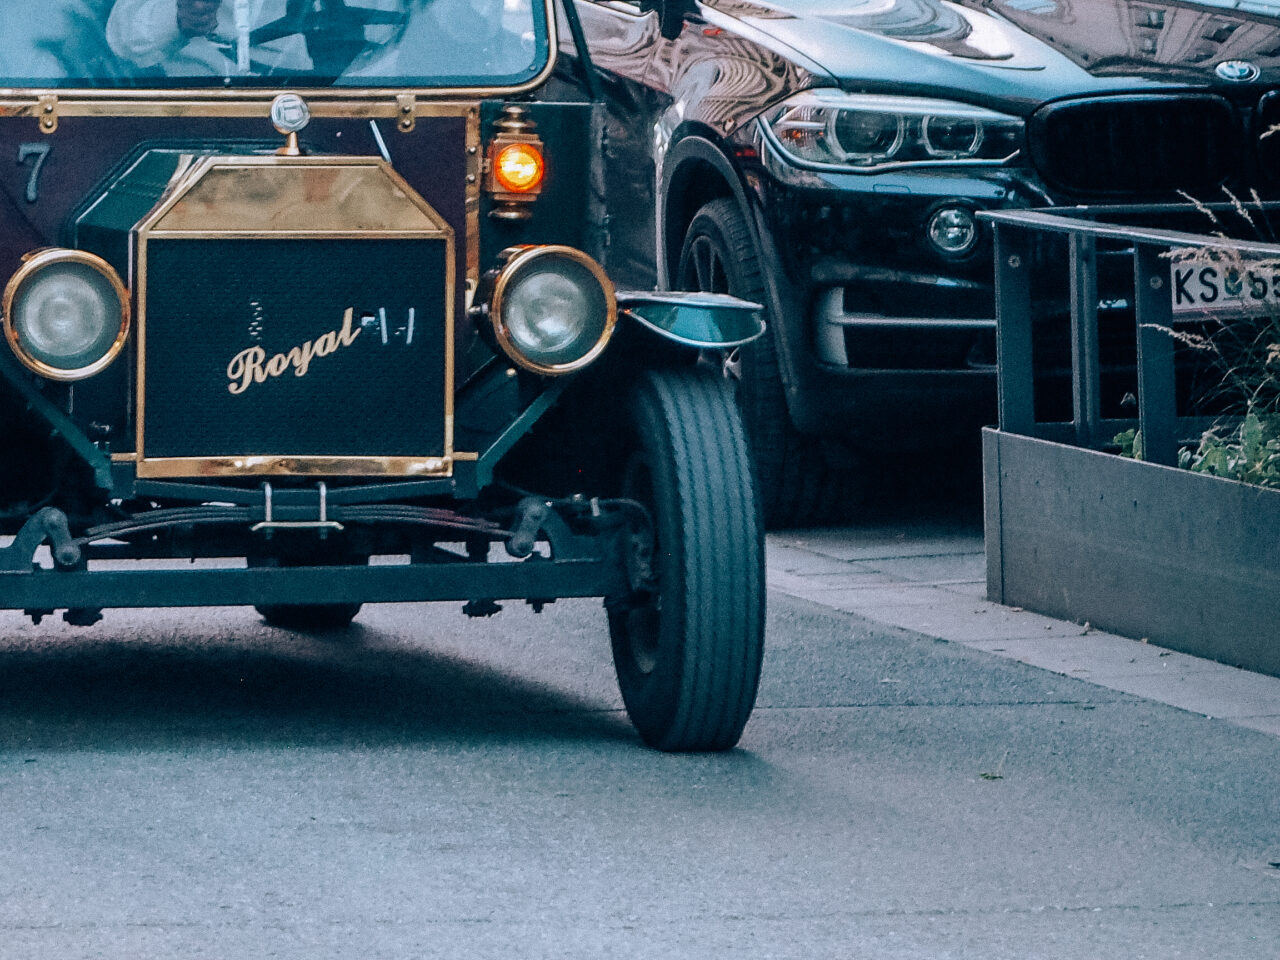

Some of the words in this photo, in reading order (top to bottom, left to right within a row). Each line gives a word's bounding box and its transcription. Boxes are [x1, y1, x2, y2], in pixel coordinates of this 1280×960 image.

[19, 143, 50, 201] 7
[1175, 267, 1218, 304] KS
[227, 307, 361, 394] Royal
